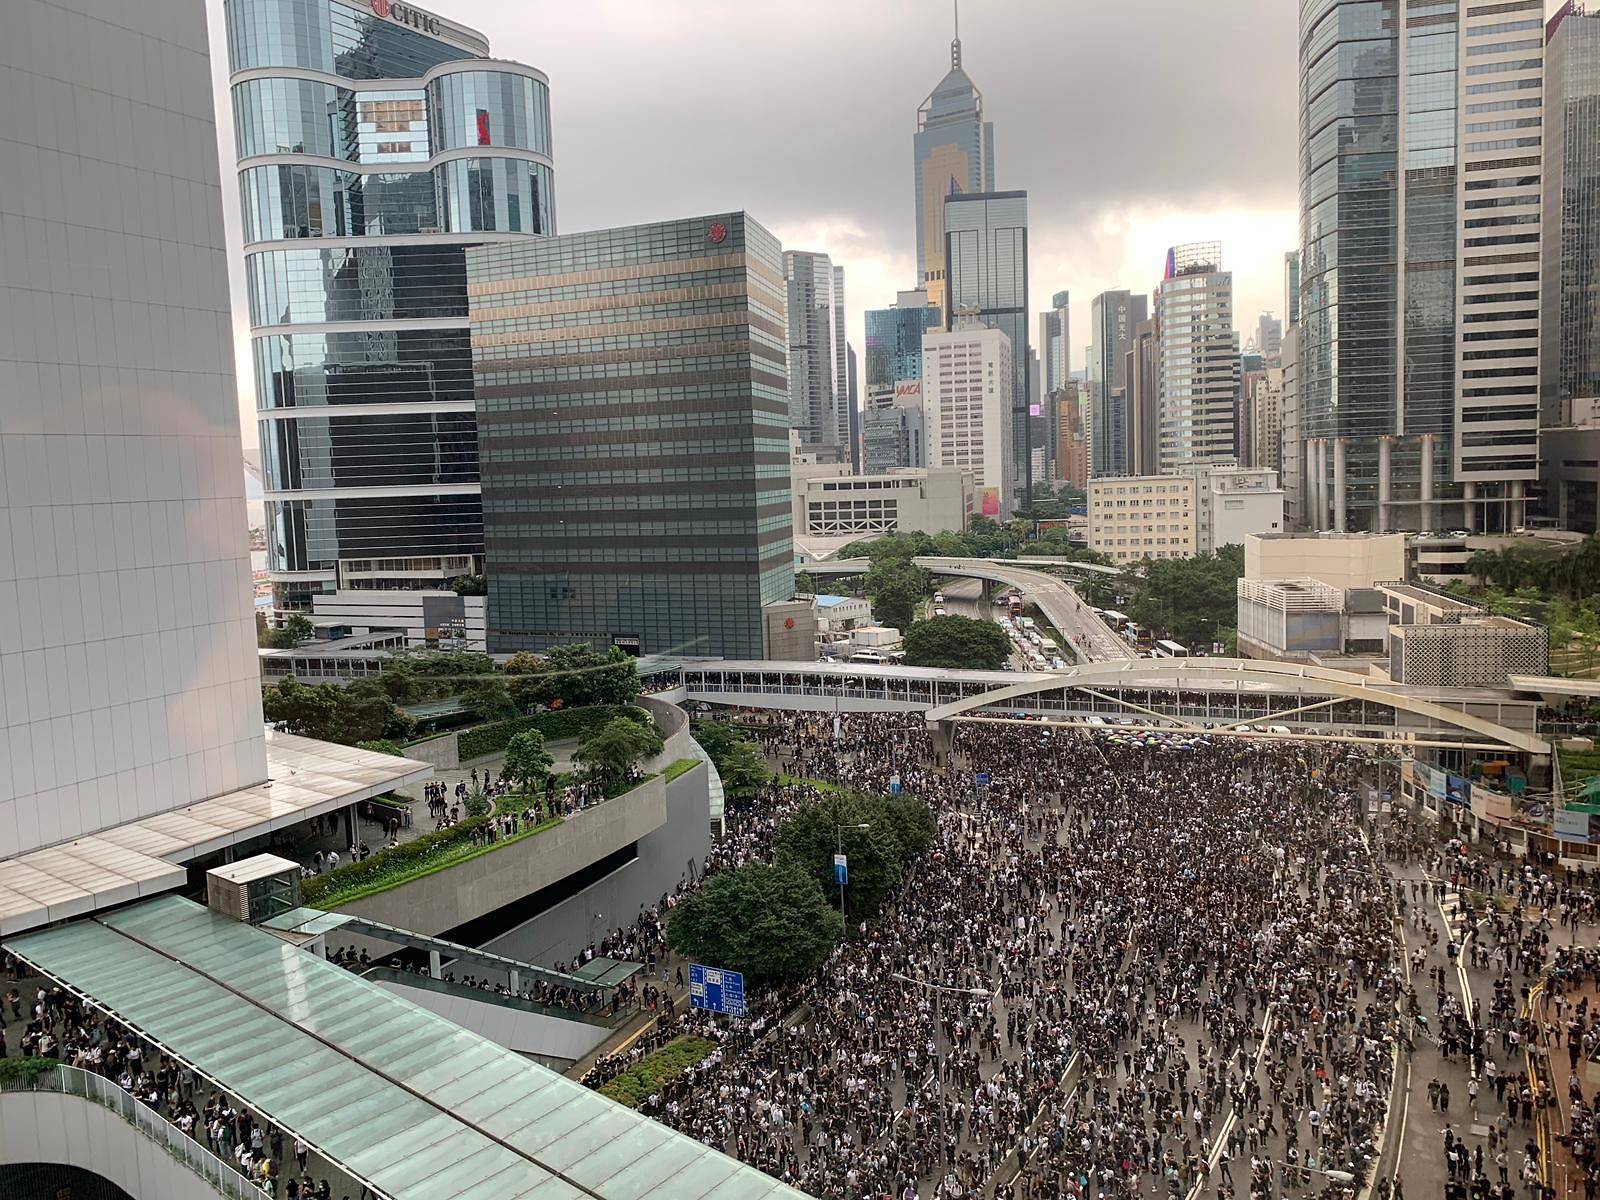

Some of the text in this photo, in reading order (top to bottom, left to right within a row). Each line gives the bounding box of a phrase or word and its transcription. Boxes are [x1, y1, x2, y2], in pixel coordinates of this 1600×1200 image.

[391, 2, 440, 36] CITIC
[1118, 305, 1127, 340] 中国光大
